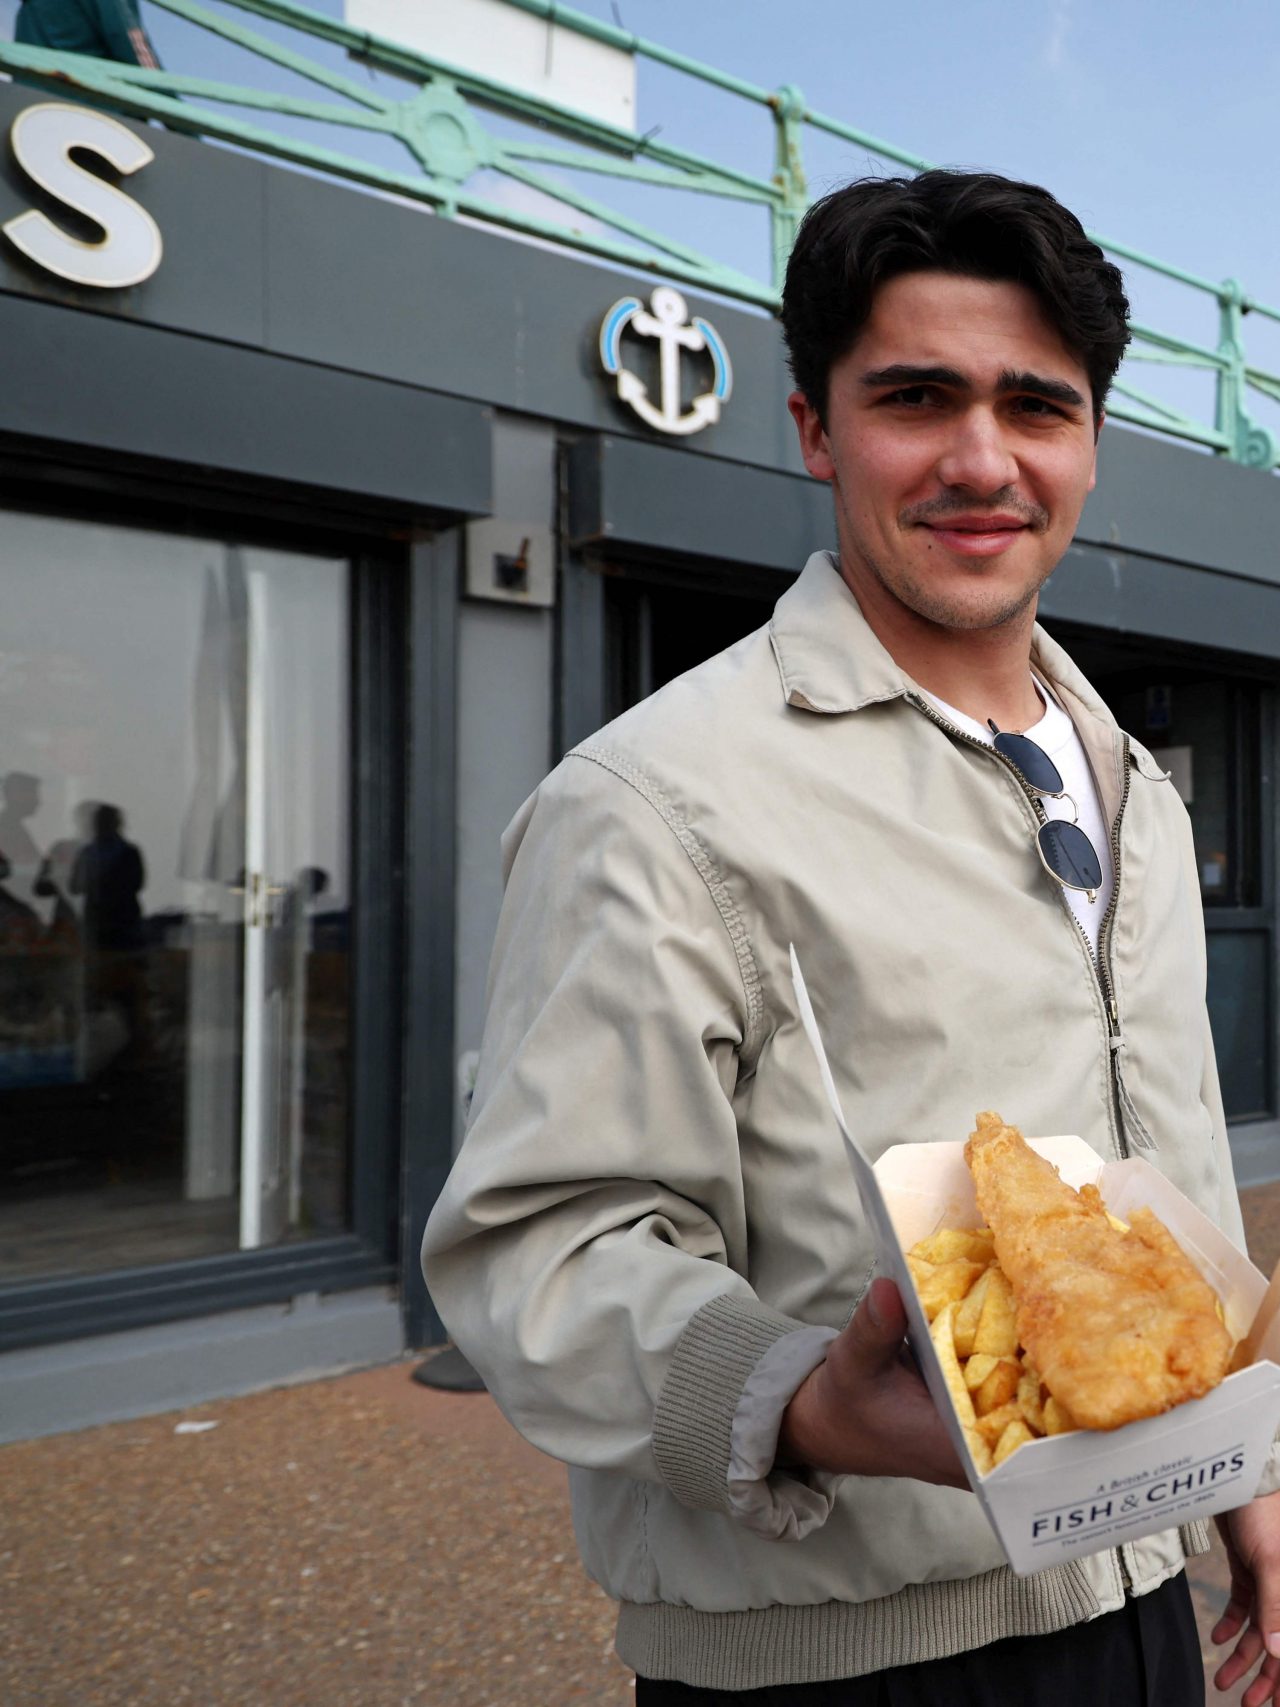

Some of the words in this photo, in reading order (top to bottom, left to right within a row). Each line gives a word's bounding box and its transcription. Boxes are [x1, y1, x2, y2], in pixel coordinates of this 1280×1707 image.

[2, 102, 163, 288] S
[1032, 1501, 1113, 1538] FISH
[1120, 1494, 1140, 1513] &
[1146, 1452, 1245, 1503] CHIPS
